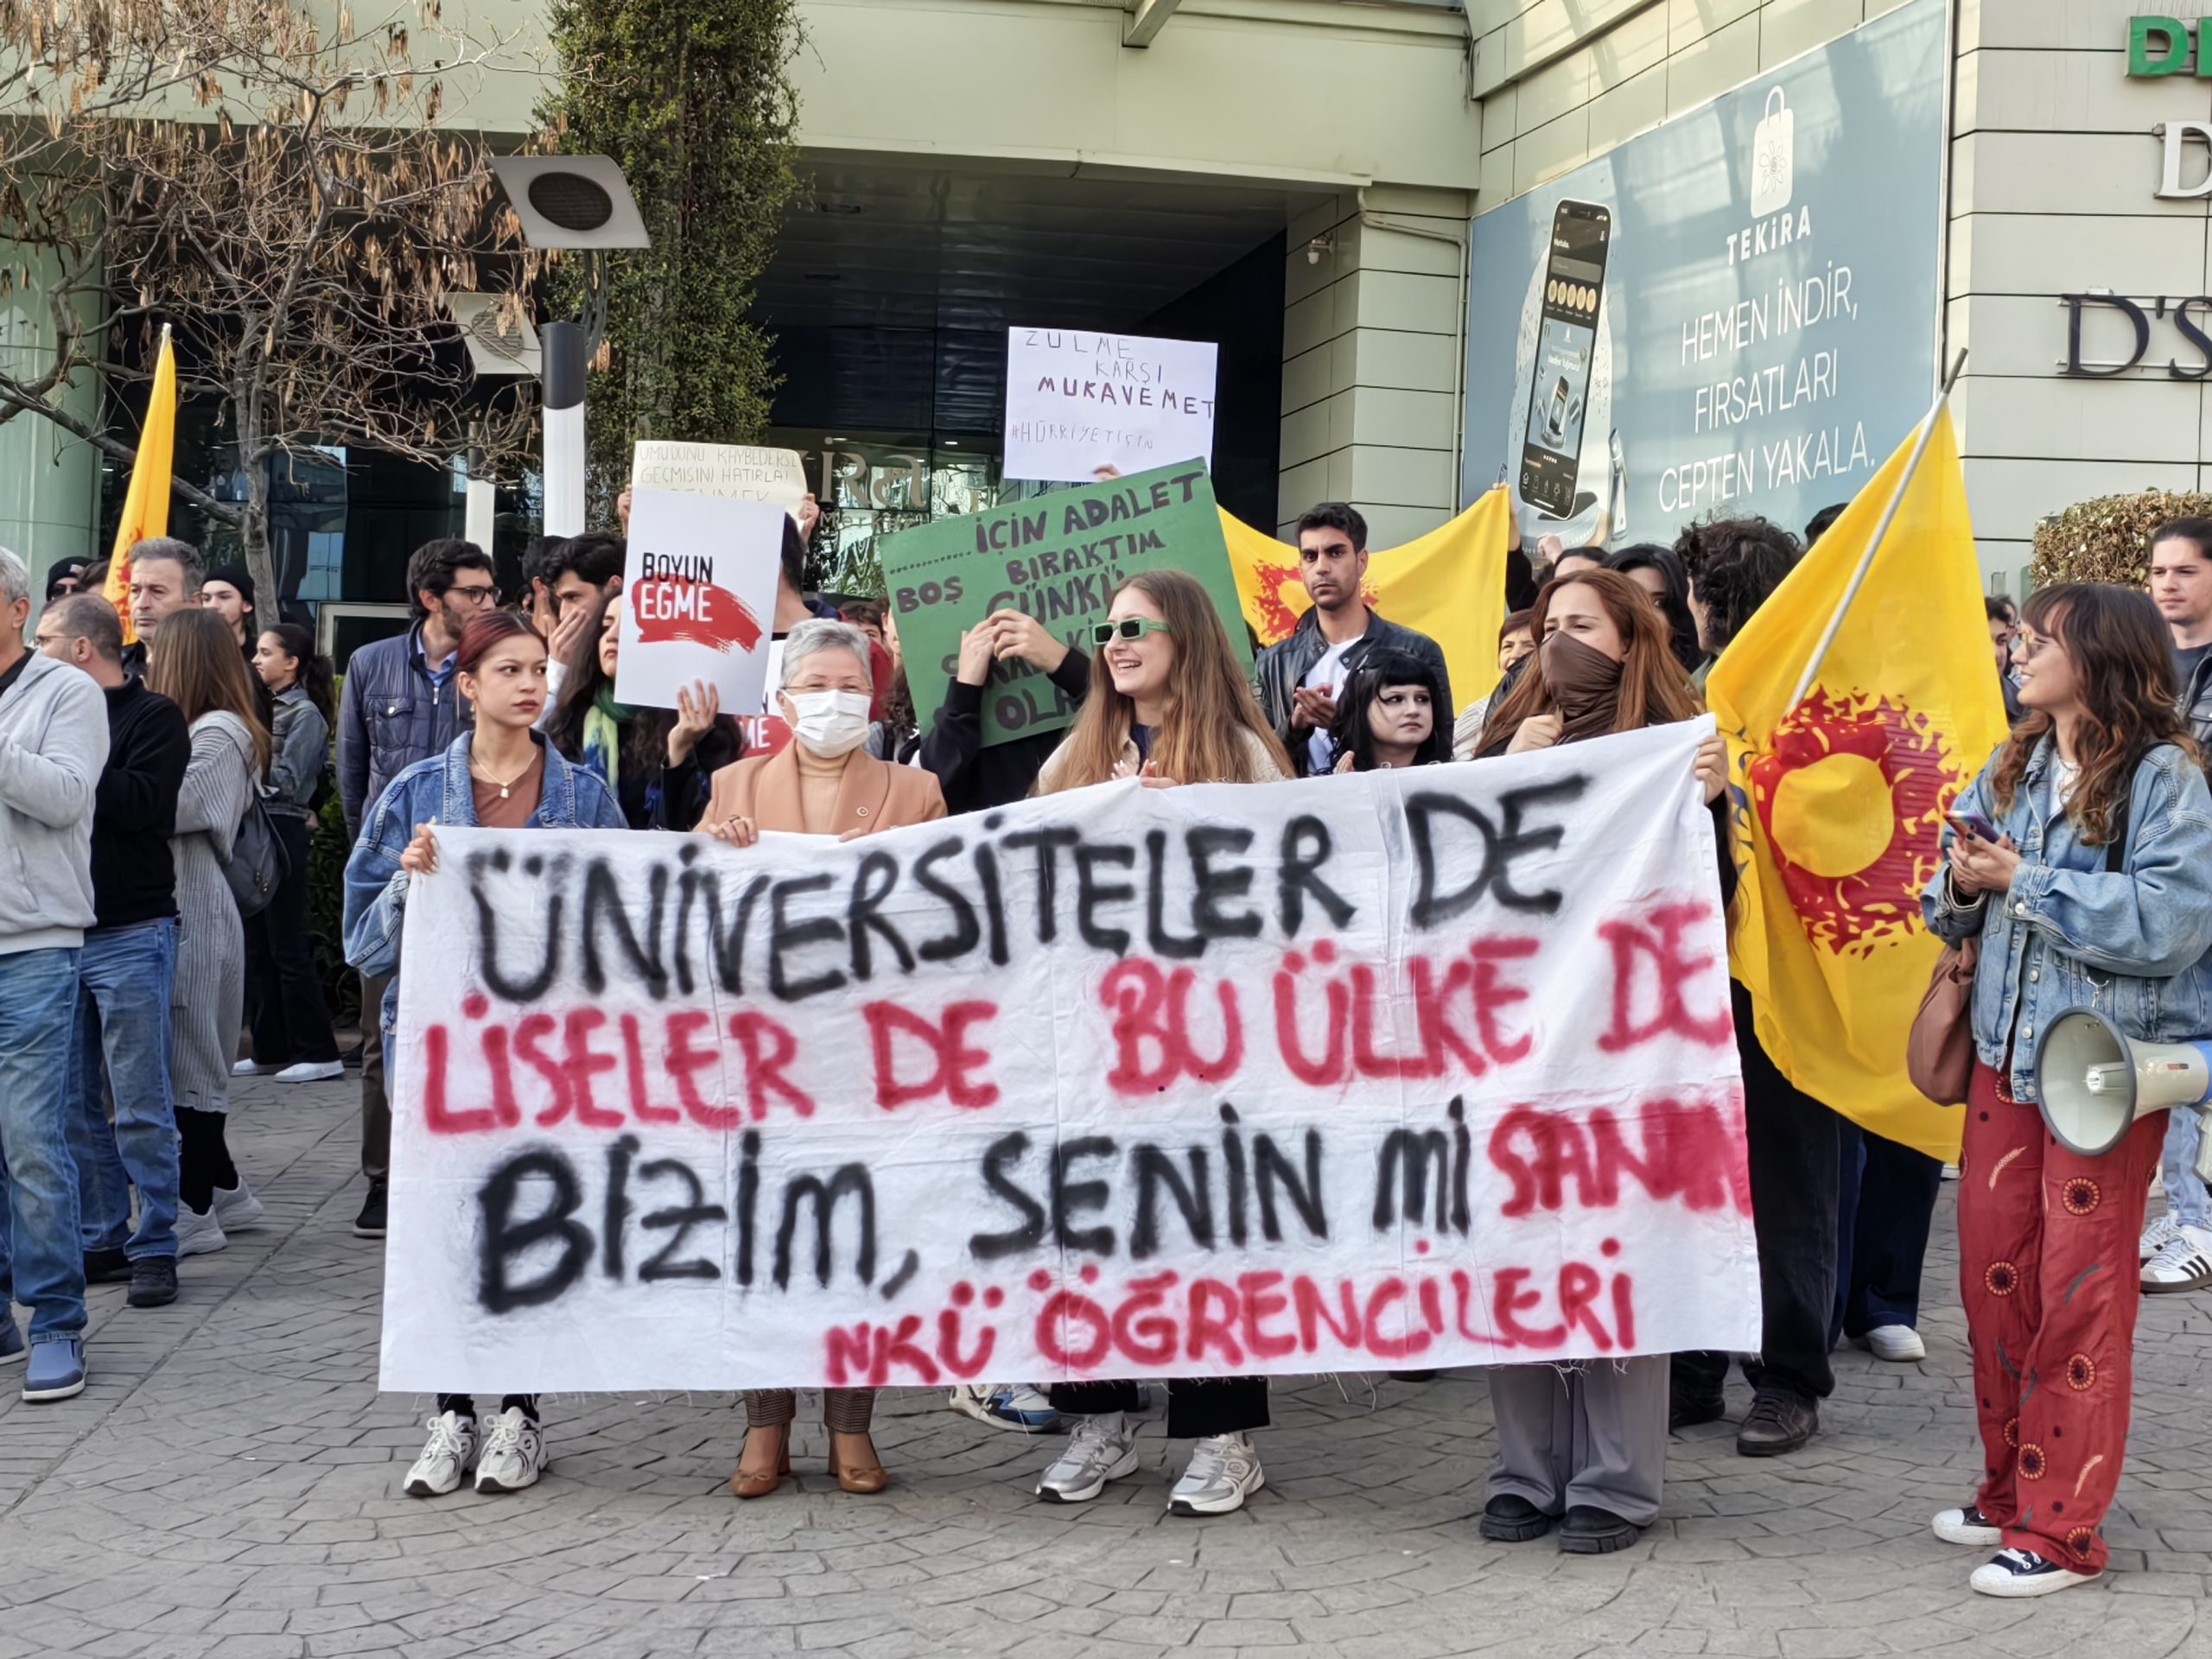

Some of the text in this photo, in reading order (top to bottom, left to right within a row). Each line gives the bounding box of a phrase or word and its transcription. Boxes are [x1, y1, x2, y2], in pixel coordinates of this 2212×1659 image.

[1026, 330, 1134, 359] ZULME
[1681, 260, 1858, 366] HEMEN İNDİR,
[1038, 377, 1214, 418] MUKAVEMET
[1096, 360, 1161, 385] KARŞI
[1694, 348, 1837, 434] FIRSATLARI
[1659, 421, 1875, 512] CEPTEN YAKALA.
[976, 511, 1046, 556] İÇİN
[1063, 471, 1205, 537] ADALET
[640, 582, 713, 621] EĞME
[642, 552, 713, 584] BOYUN
[896, 529, 1166, 613] BOŞ BIRAKTIM
[467, 774, 1590, 1004] ÜNİVERSİTELER DE
[423, 900, 1735, 1137] LİSELER DE BU ÜLKE DE
[967, 1093, 1329, 1262] SENİN
[823, 1236, 1637, 1388] NKÜ ÖĞRENCİLERİ
